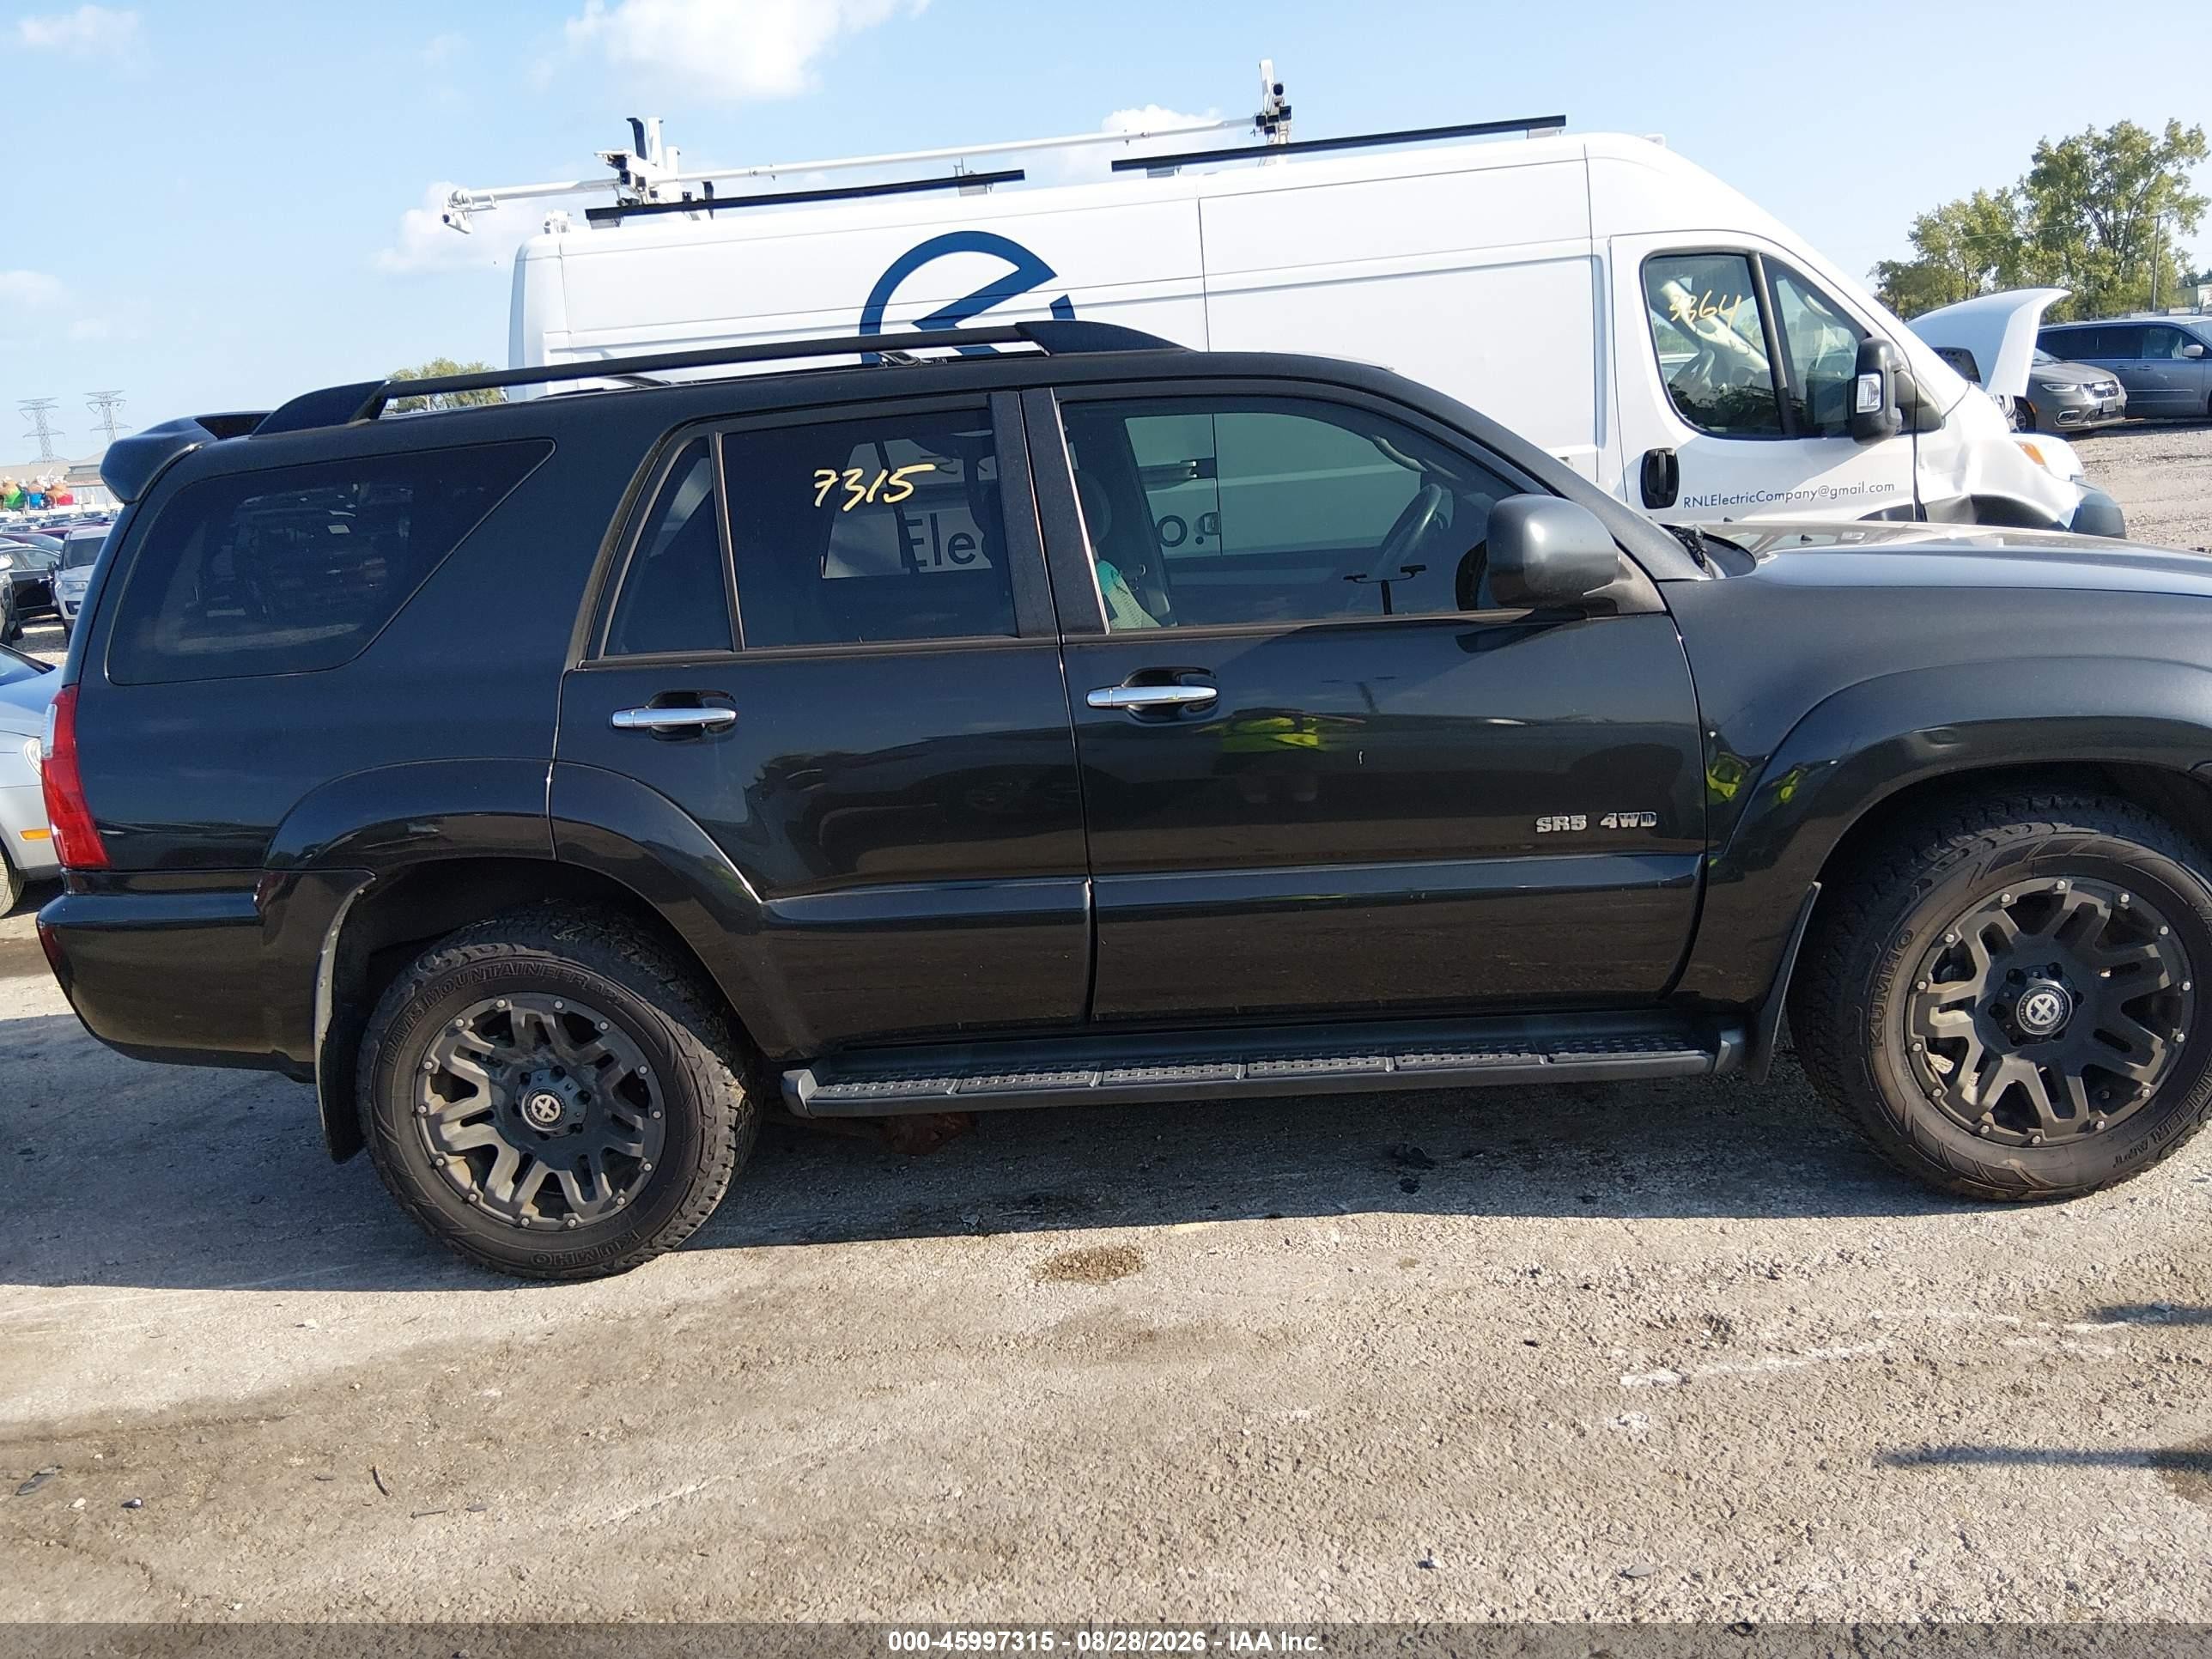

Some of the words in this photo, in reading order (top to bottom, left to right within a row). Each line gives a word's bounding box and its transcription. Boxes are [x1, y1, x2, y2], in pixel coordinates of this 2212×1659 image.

[813, 463, 936, 512] 7315
[1684, 481, 1894, 508] RNLElectricCompany@gmail.com
[1536, 815, 1587, 832] SR5
[1601, 811, 1656, 829] 4WD
[1870, 929, 1914, 1048] KUMHO
